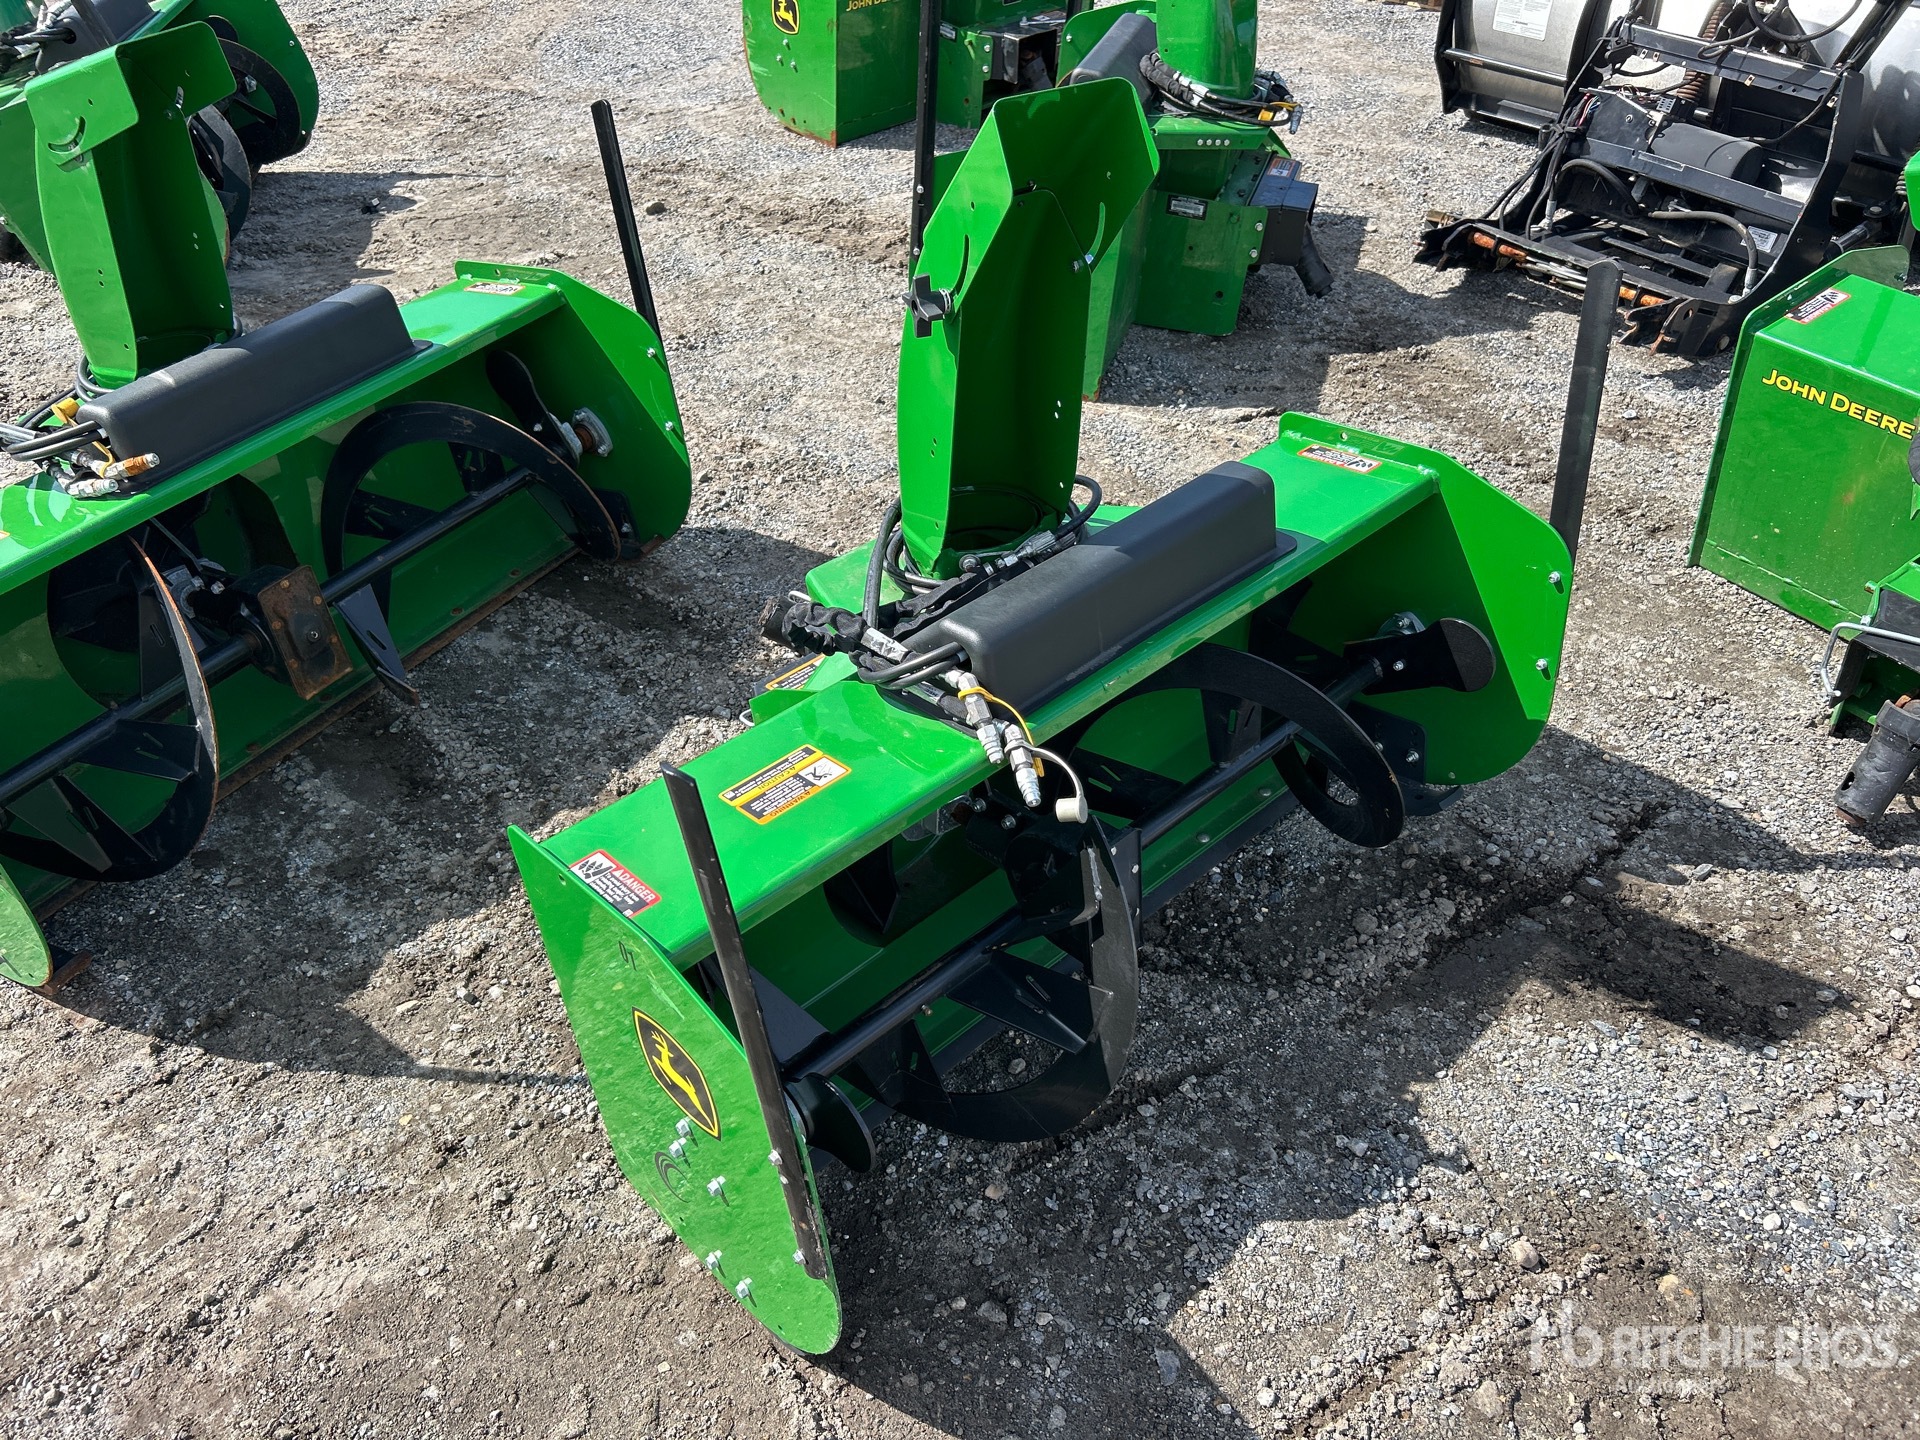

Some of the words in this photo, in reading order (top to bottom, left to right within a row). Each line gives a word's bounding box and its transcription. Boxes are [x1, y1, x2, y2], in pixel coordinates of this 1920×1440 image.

[1762, 369, 1827, 405] JOHN
[1830, 392, 1915, 440] DEERE
[621, 872, 656, 903] DANGER
